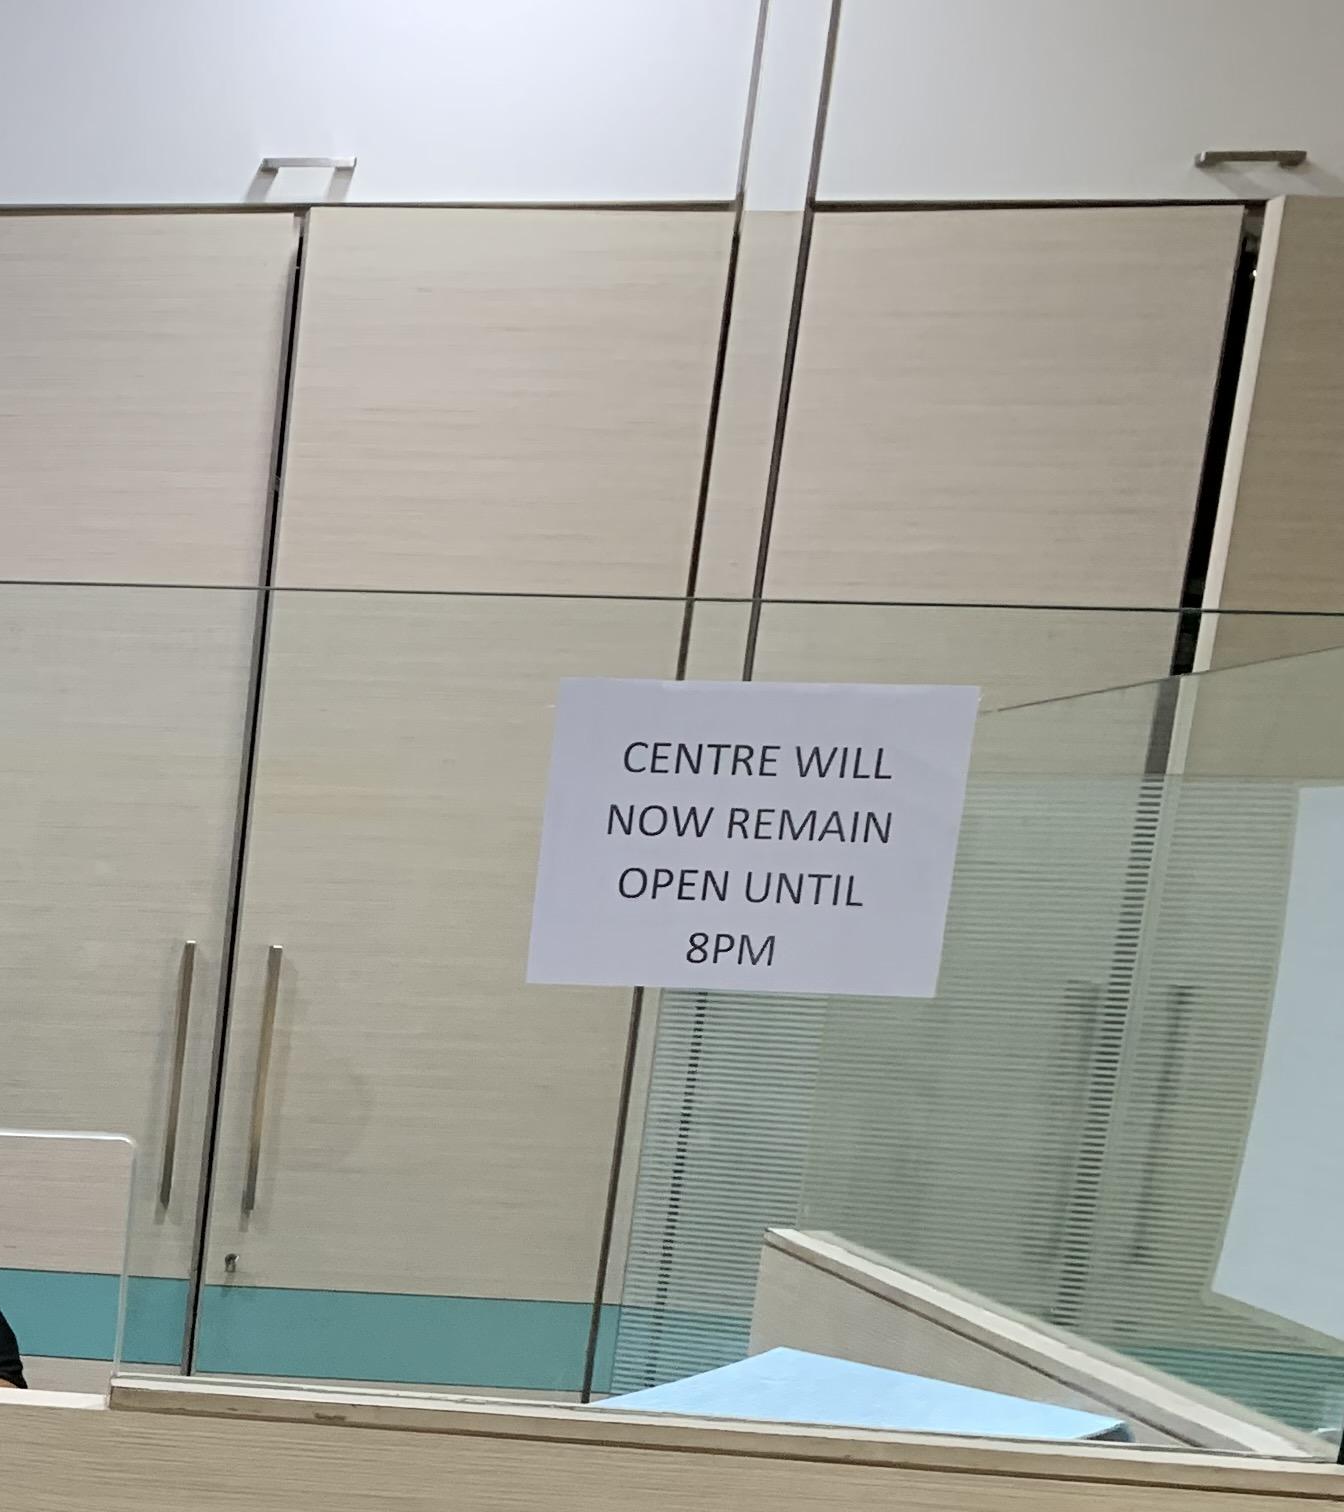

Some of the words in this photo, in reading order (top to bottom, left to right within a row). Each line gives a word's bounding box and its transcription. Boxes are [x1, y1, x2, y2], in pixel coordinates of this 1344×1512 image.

[623, 741, 781, 778] CENTRE
[796, 745, 893, 780] WILL
[606, 803, 714, 839] NOW
[726, 807, 893, 844] REMAIN
[618, 866, 729, 902] OPEN
[744, 872, 864, 907] UNTIL
[685, 931, 776, 967] 8PM
